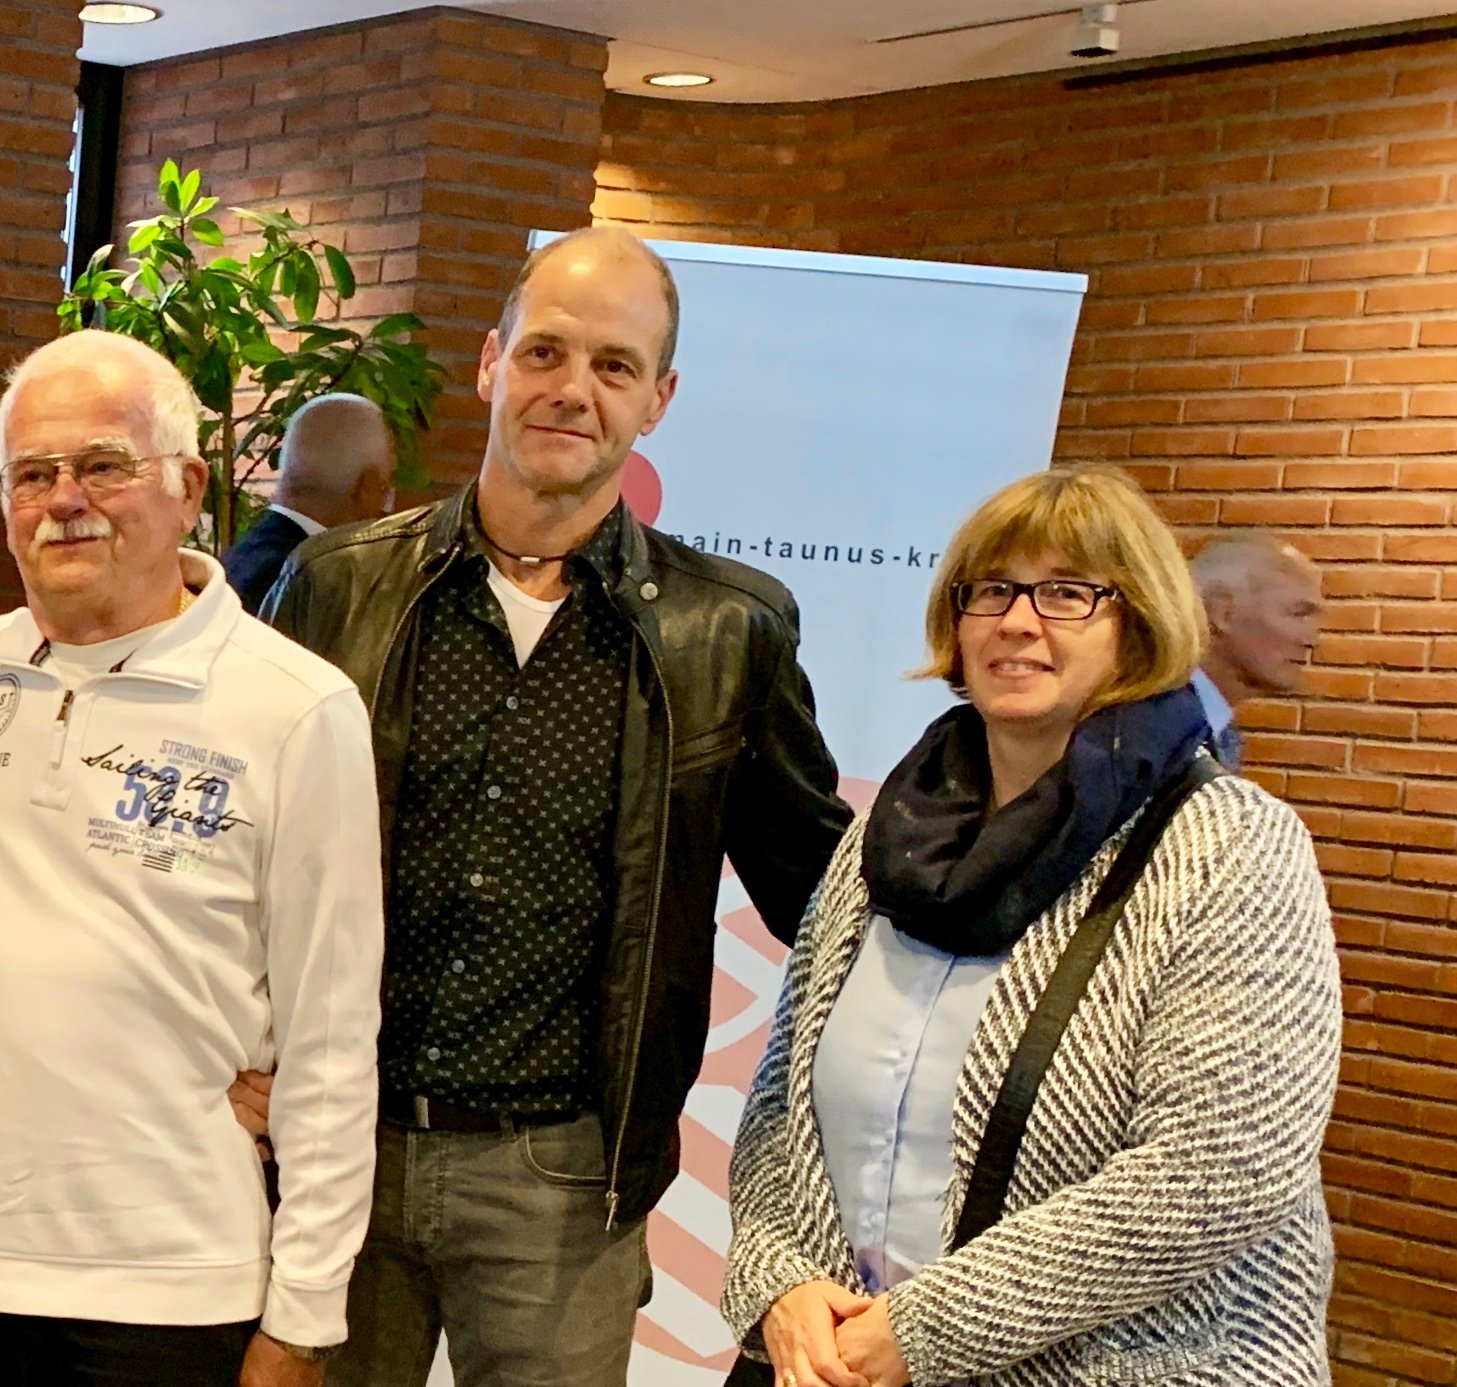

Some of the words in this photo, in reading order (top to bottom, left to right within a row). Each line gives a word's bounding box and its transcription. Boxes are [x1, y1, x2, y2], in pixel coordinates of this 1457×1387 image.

[81, 744, 179, 802] Sailing
[183, 770, 227, 796] the
[159, 739, 208, 763] STRONG
[209, 751, 249, 776] FINISH
[147, 789, 255, 832] Giants
[86, 829, 132, 845] ATLANTIC
